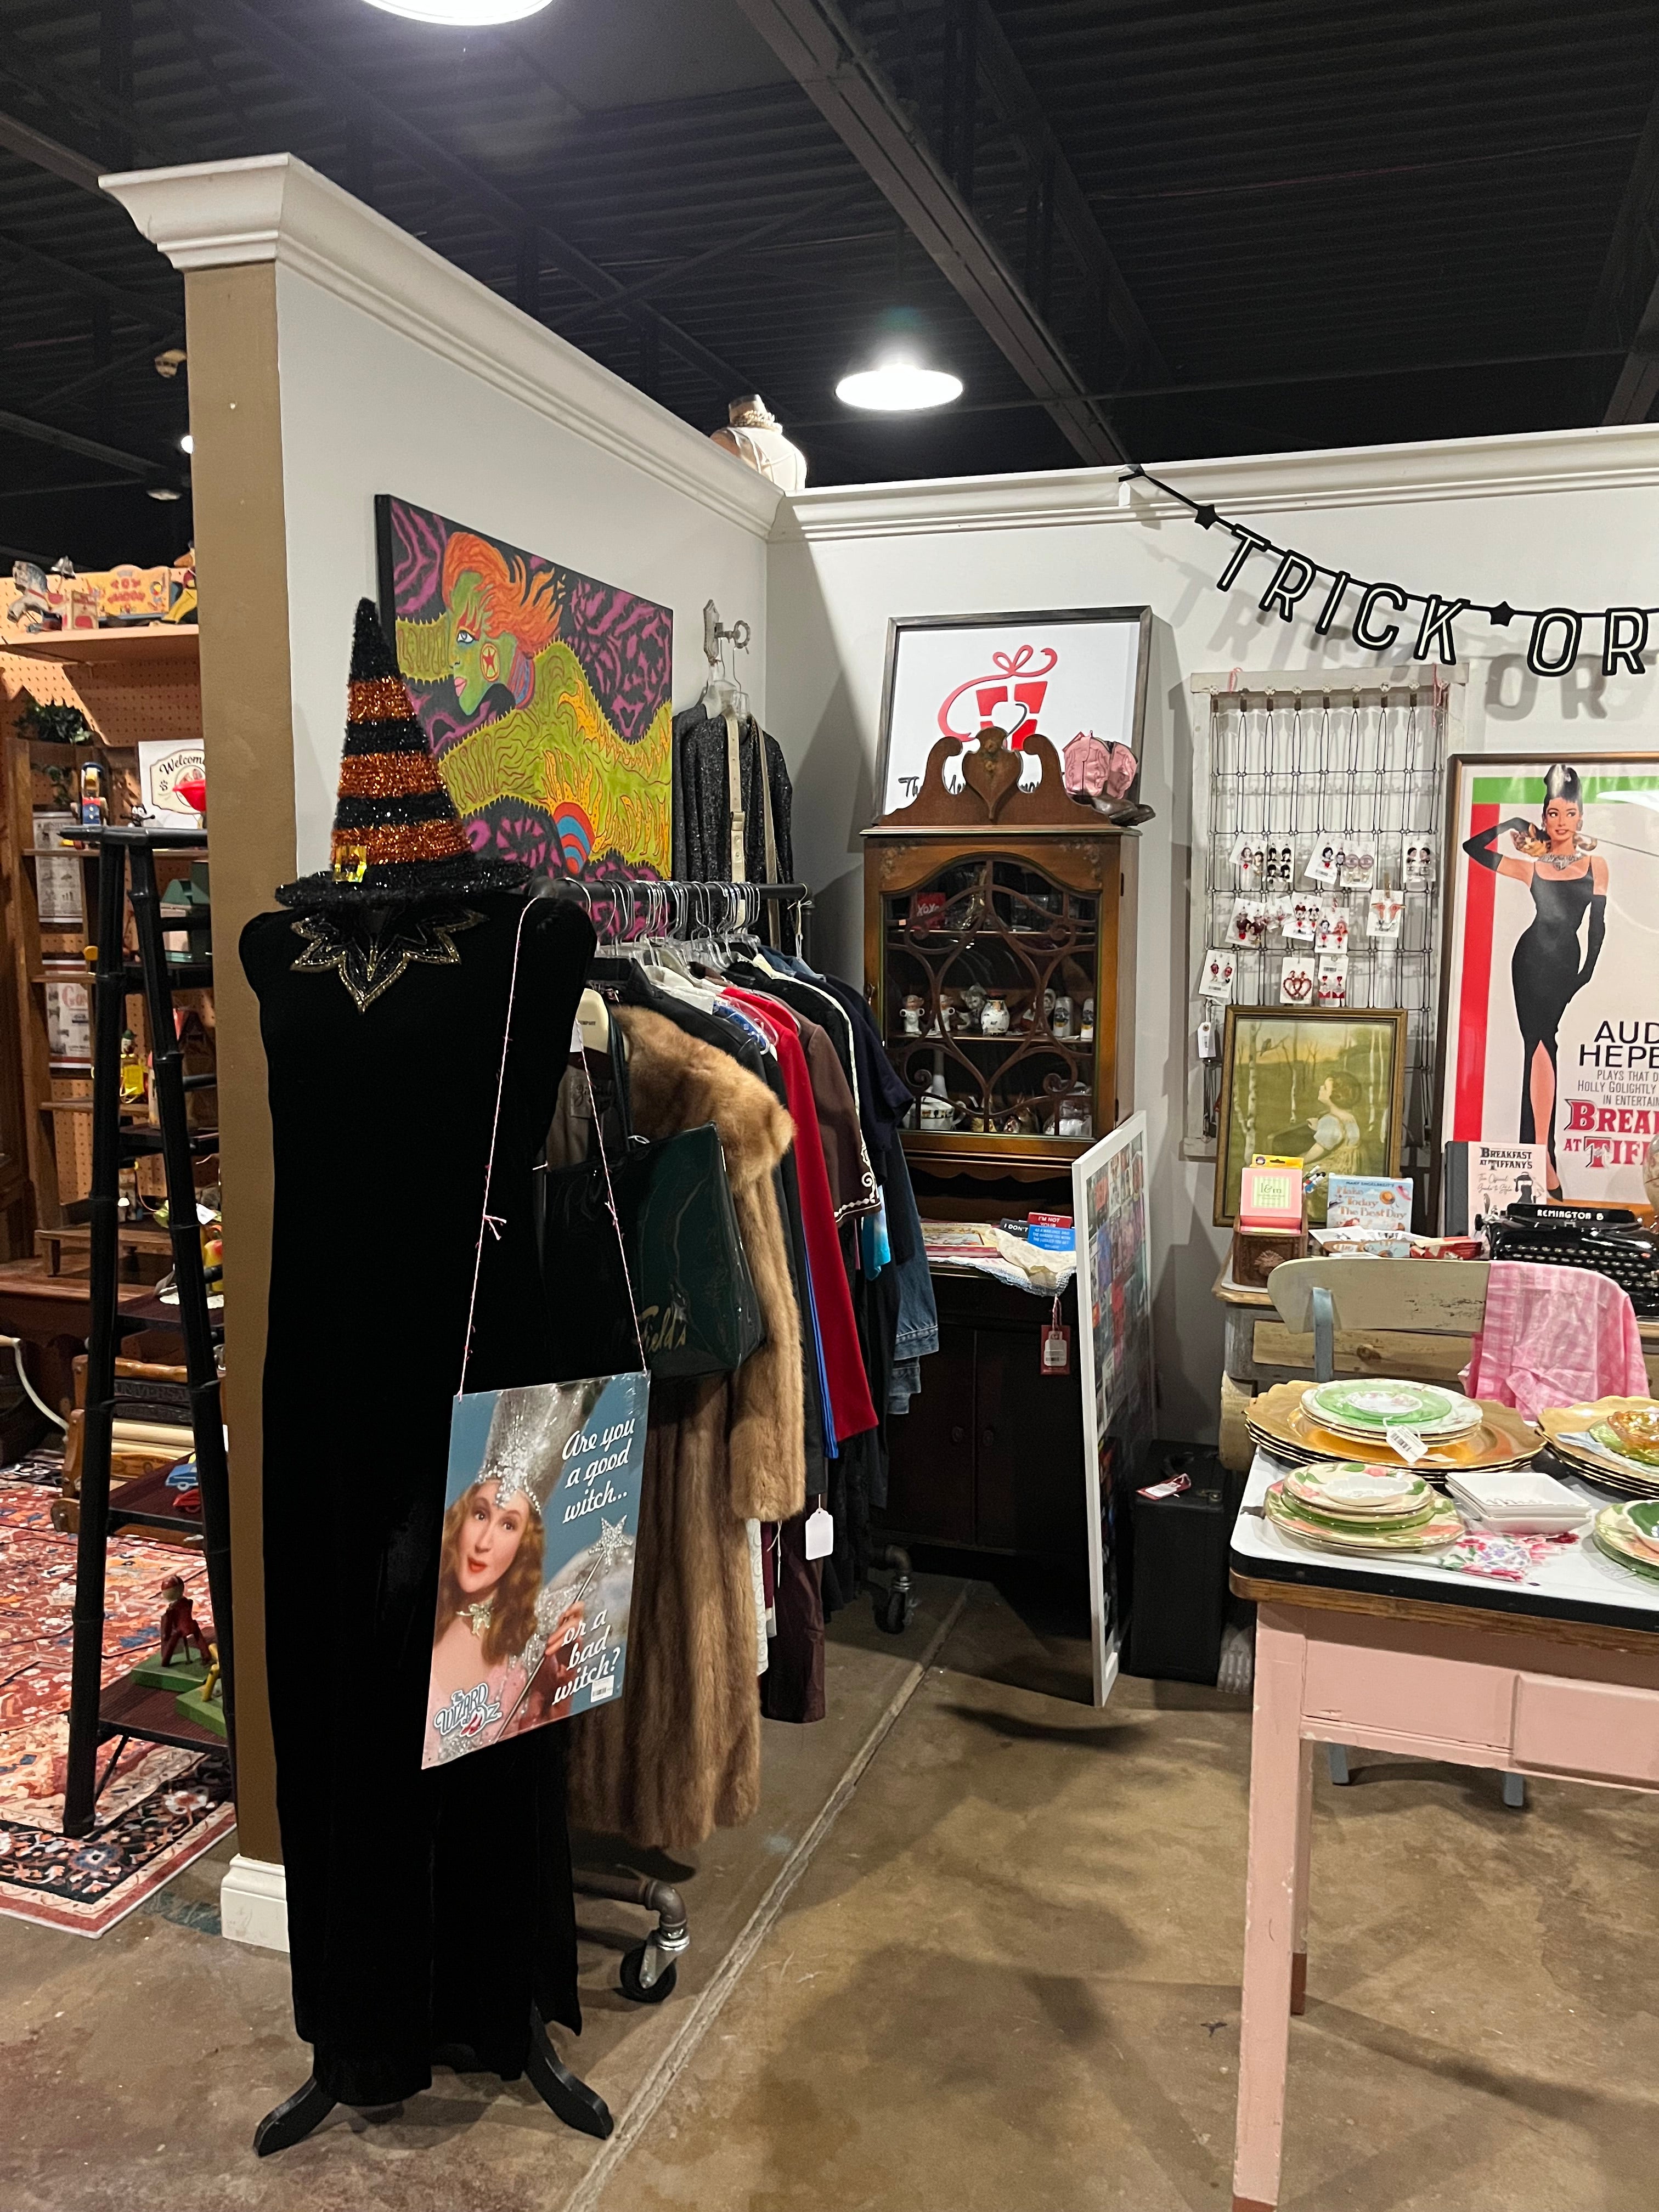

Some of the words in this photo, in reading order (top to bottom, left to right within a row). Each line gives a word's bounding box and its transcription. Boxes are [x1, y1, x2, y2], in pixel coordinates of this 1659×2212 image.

[1216, 523, 1470, 665] TRICK
[1527, 607, 1647, 676] OR
[1594, 1020, 1659, 1044] AUD
[1597, 1070, 1624, 1081] PLAYS
[1628, 1071, 1650, 1081] THAT
[1578, 1080, 1605, 1092] HOLLY
[1609, 1081, 1656, 1094] GOLIGHTLY
[1603, 1094, 1611, 1104] IN
[1479, 1147, 1532, 1159] BREAKFAST
[1563, 1138, 1582, 1152] AT
[1345, 1195, 1379, 1207] Today
[1339, 1206, 1358, 1215] The
[1361, 1207, 1385, 1216] Best
[1386, 1209, 1407, 1220] Day
[1537, 1209, 1592, 1220] REMINGTON
[1008, 1224, 1029, 1232] DON'T
[562, 1430, 598, 1460] Are
[600, 1418, 635, 1452] you
[565, 1467, 581, 1488] a
[583, 1438, 633, 1486] good
[562, 1480, 627, 1524] witch...
[562, 1620, 586, 1646] or
[590, 1609, 607, 1631] a
[566, 1625, 611, 1671] bad
[552, 1647, 621, 1705] witch?
[436, 1684, 487, 1734] WIZARD
